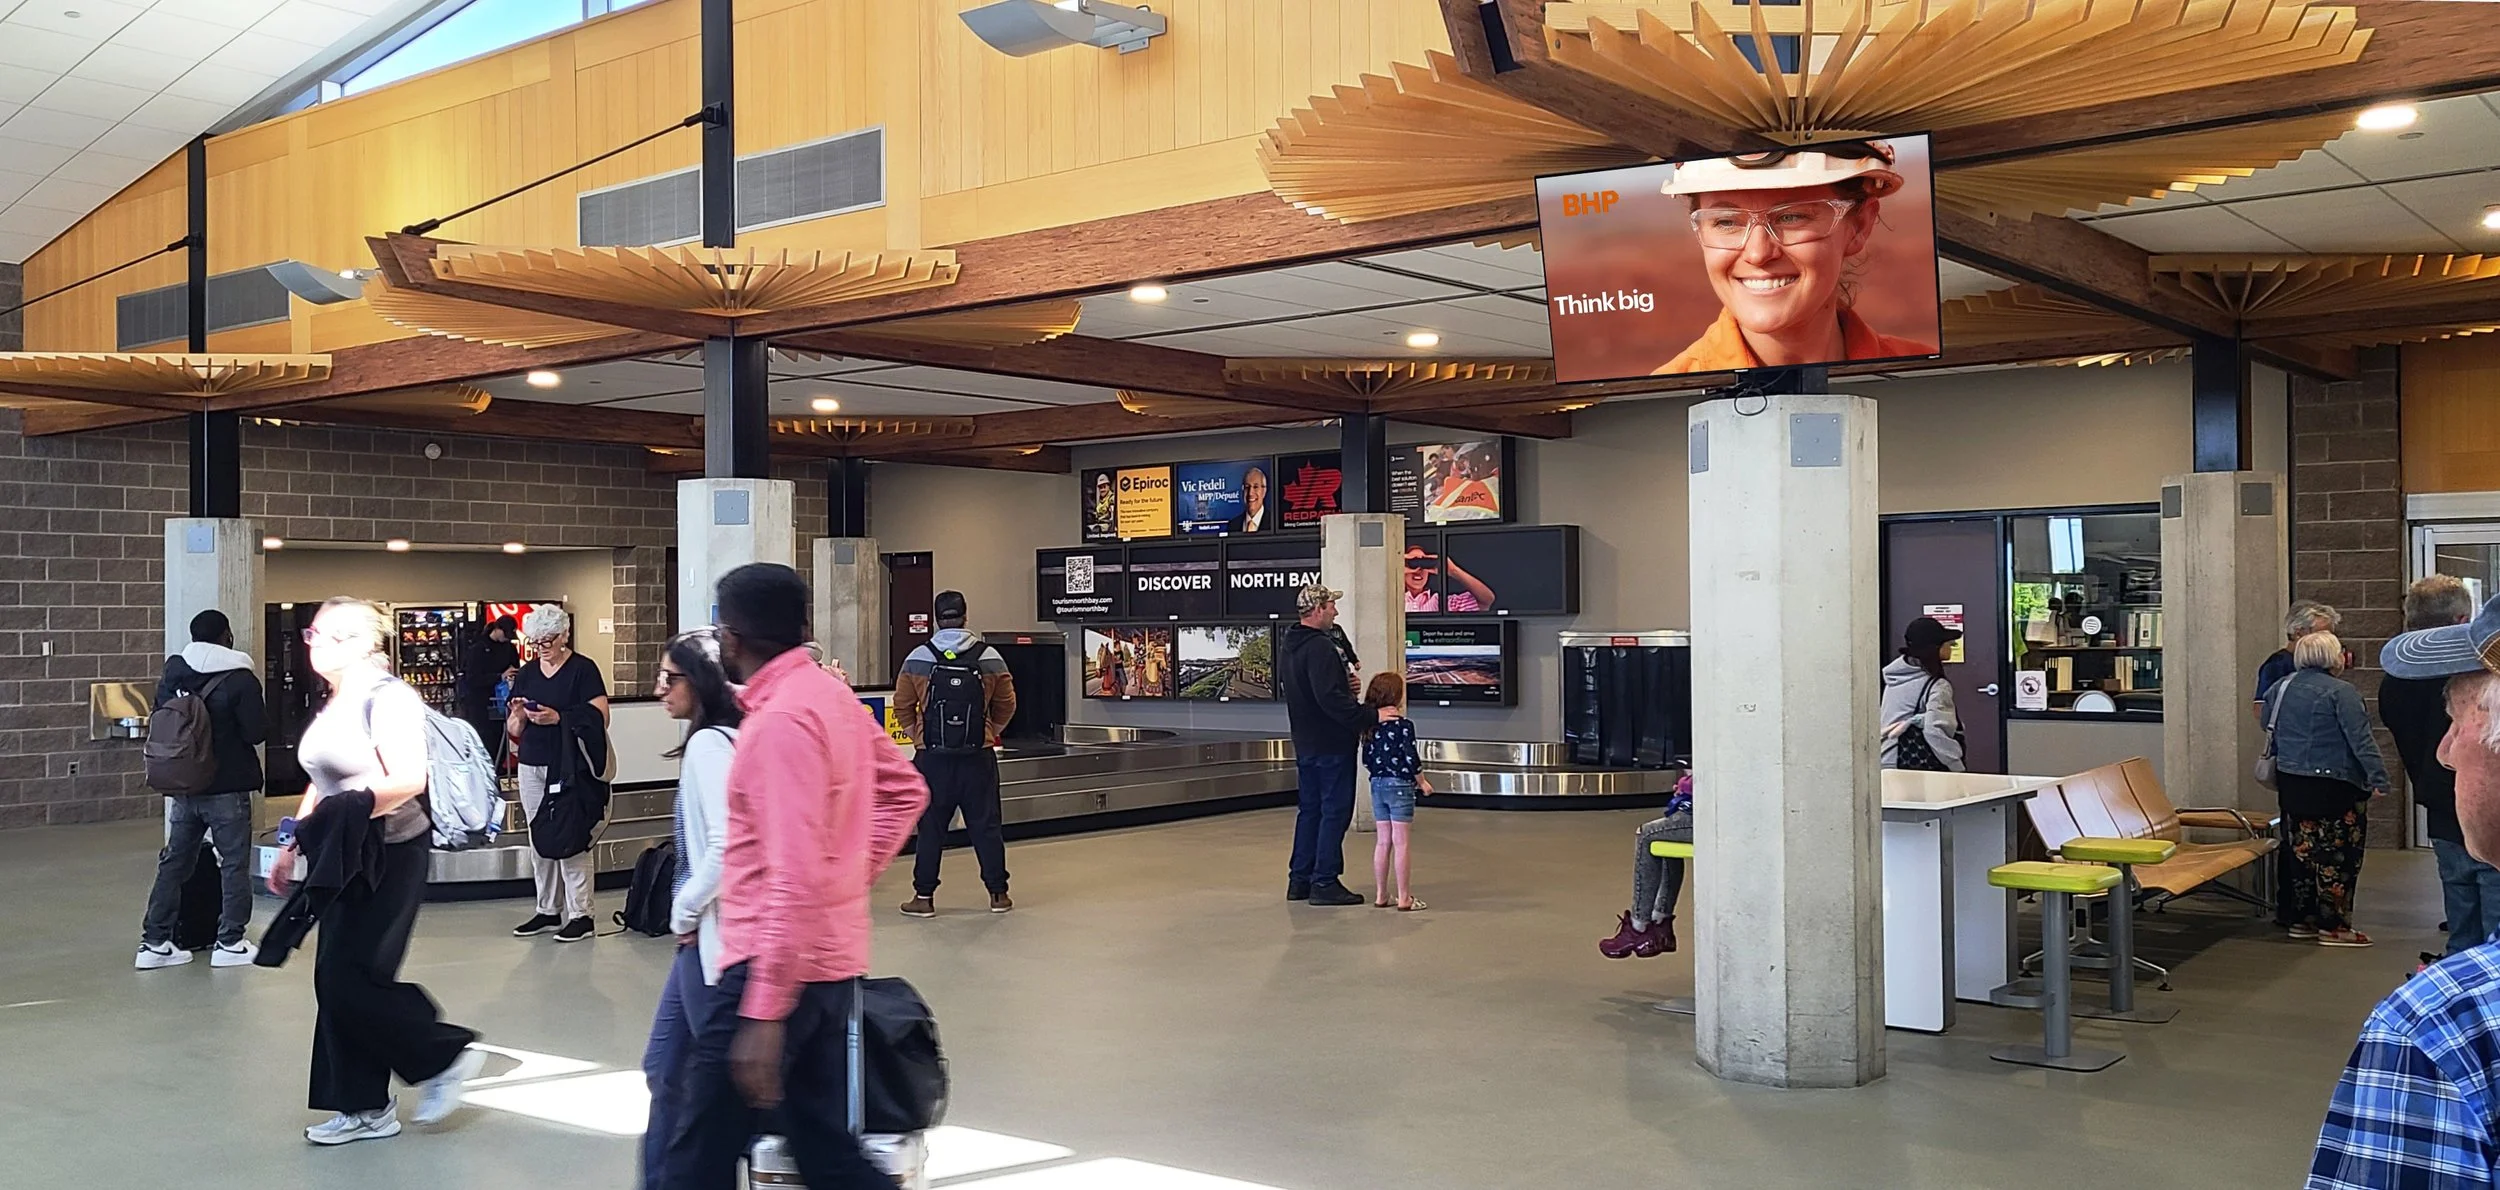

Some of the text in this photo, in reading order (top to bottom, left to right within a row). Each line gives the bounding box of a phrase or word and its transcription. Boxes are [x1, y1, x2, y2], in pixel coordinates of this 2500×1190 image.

[1562, 189, 1620, 217] BHP
[1553, 288, 1655, 316] Think big
[1132, 476, 1169, 493] Epiroc
[1181, 478, 1226, 492] Vic Fedeli
[1198, 491, 1240, 502] MPP/Député
[1138, 574, 1211, 591] DISCOVER
[1230, 571, 1321, 588] NORTH BAY
[1052, 597, 1113, 605] tourismnorthbay.com
[1056, 605, 1109, 614] @tourismnorthbay
